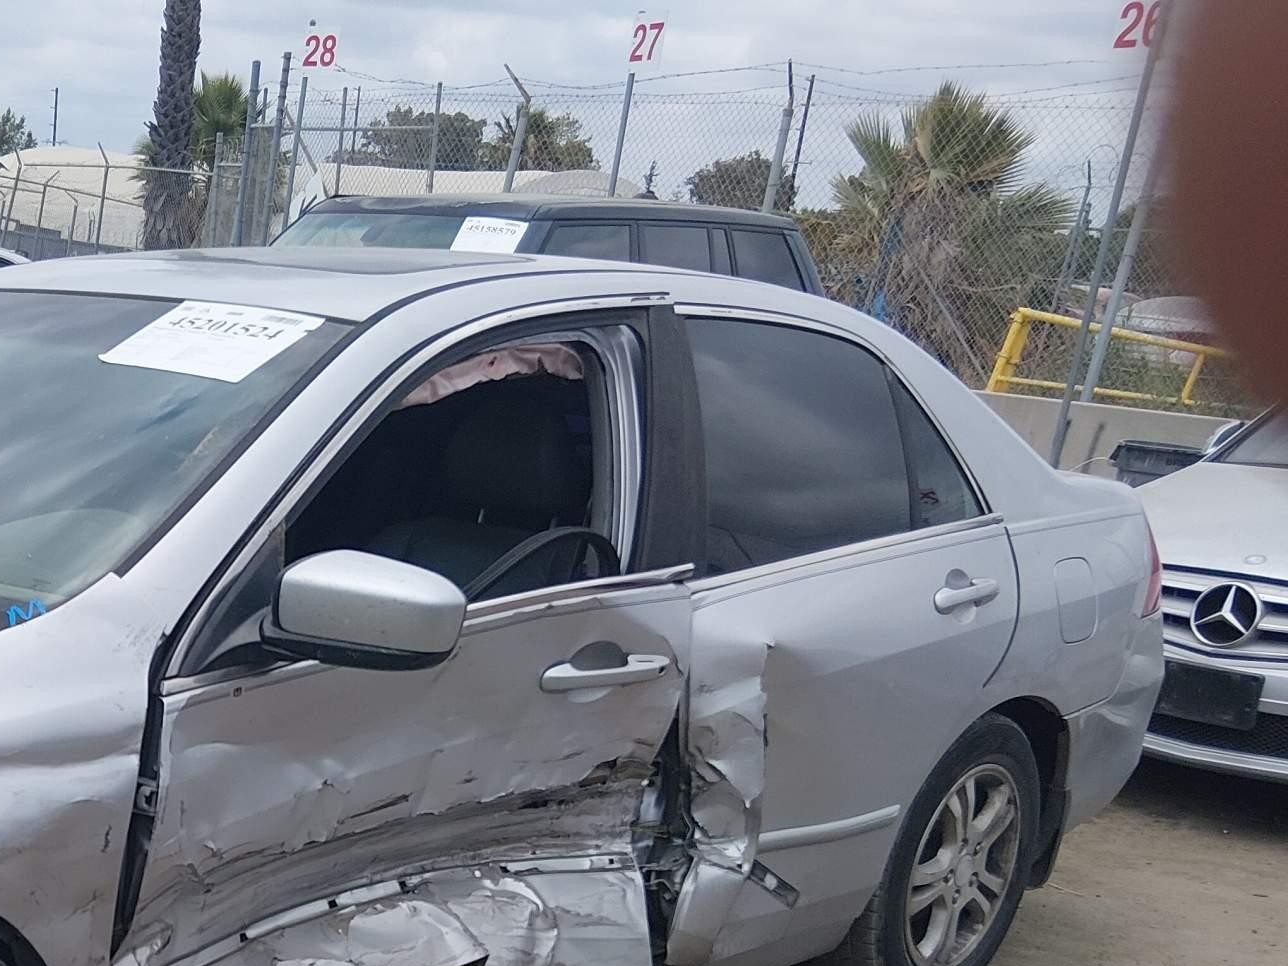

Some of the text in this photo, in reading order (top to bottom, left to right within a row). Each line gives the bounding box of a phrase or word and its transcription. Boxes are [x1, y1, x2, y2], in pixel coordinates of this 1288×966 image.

[302, 35, 337, 67] 28
[629, 22, 665, 62] 27
[168, 316, 285, 341] 45201524
